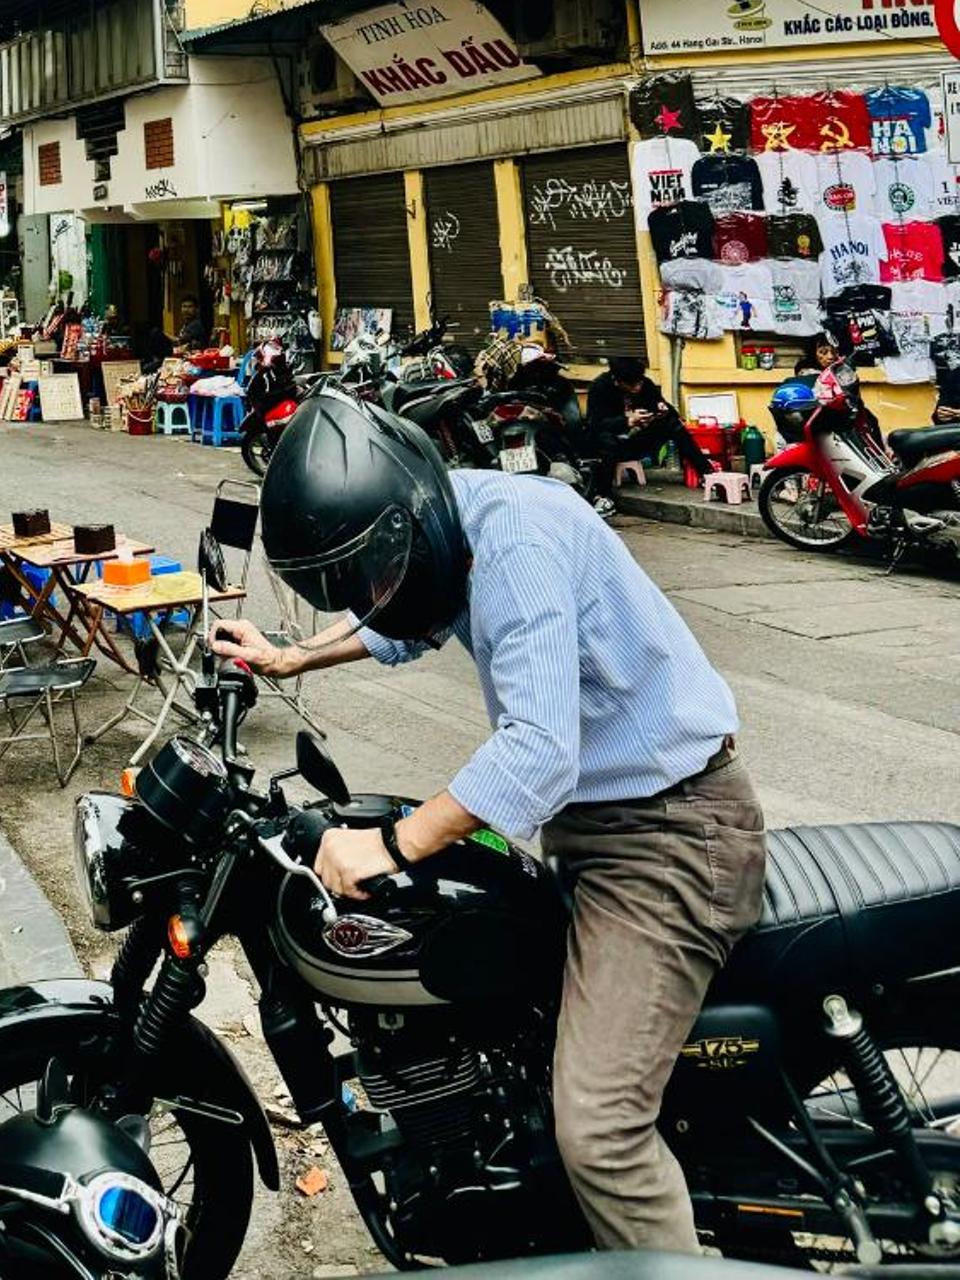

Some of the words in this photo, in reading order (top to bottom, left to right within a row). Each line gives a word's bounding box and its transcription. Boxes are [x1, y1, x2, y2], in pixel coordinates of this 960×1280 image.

[356, 17, 406, 45] TINH
[404, 6, 448, 30] HOA
[856, 14, 889, 33] LOẠI
[361, 52, 447, 97] KHẮC
[442, 35, 522, 79] DẤU
[871, 120, 914, 138] HA
[871, 135, 918, 155] NOI
[649, 174, 684, 190] VIET
[650, 188, 687, 203] NAM
[829, 240, 870, 262] HANOI
[700, 1038, 744, 1058] 175
